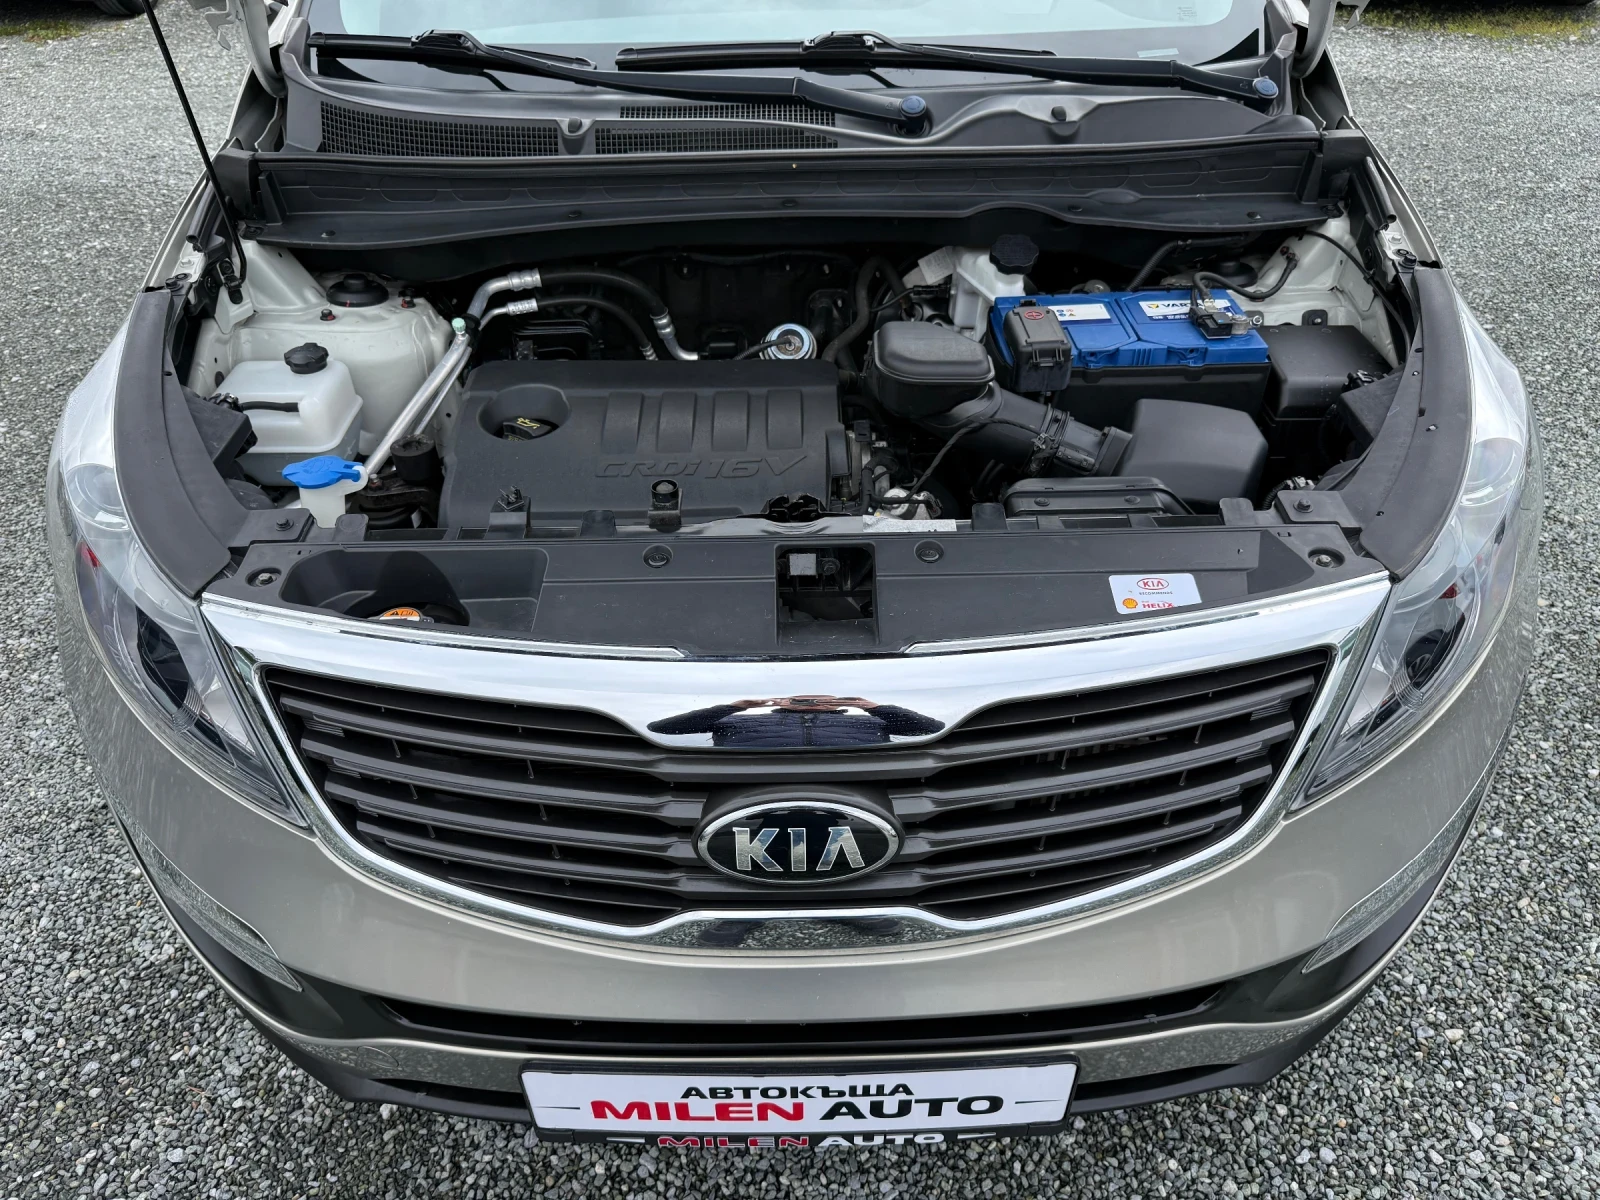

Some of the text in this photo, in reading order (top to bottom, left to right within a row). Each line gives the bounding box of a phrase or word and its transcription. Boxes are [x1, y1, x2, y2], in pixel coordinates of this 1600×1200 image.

[1142, 580, 1164, 588] KIA
[732, 826, 866, 872] KIA
[591, 1095, 1004, 1121] MILEN AUTO
[657, 1132, 945, 1148] MILEN AUTO
